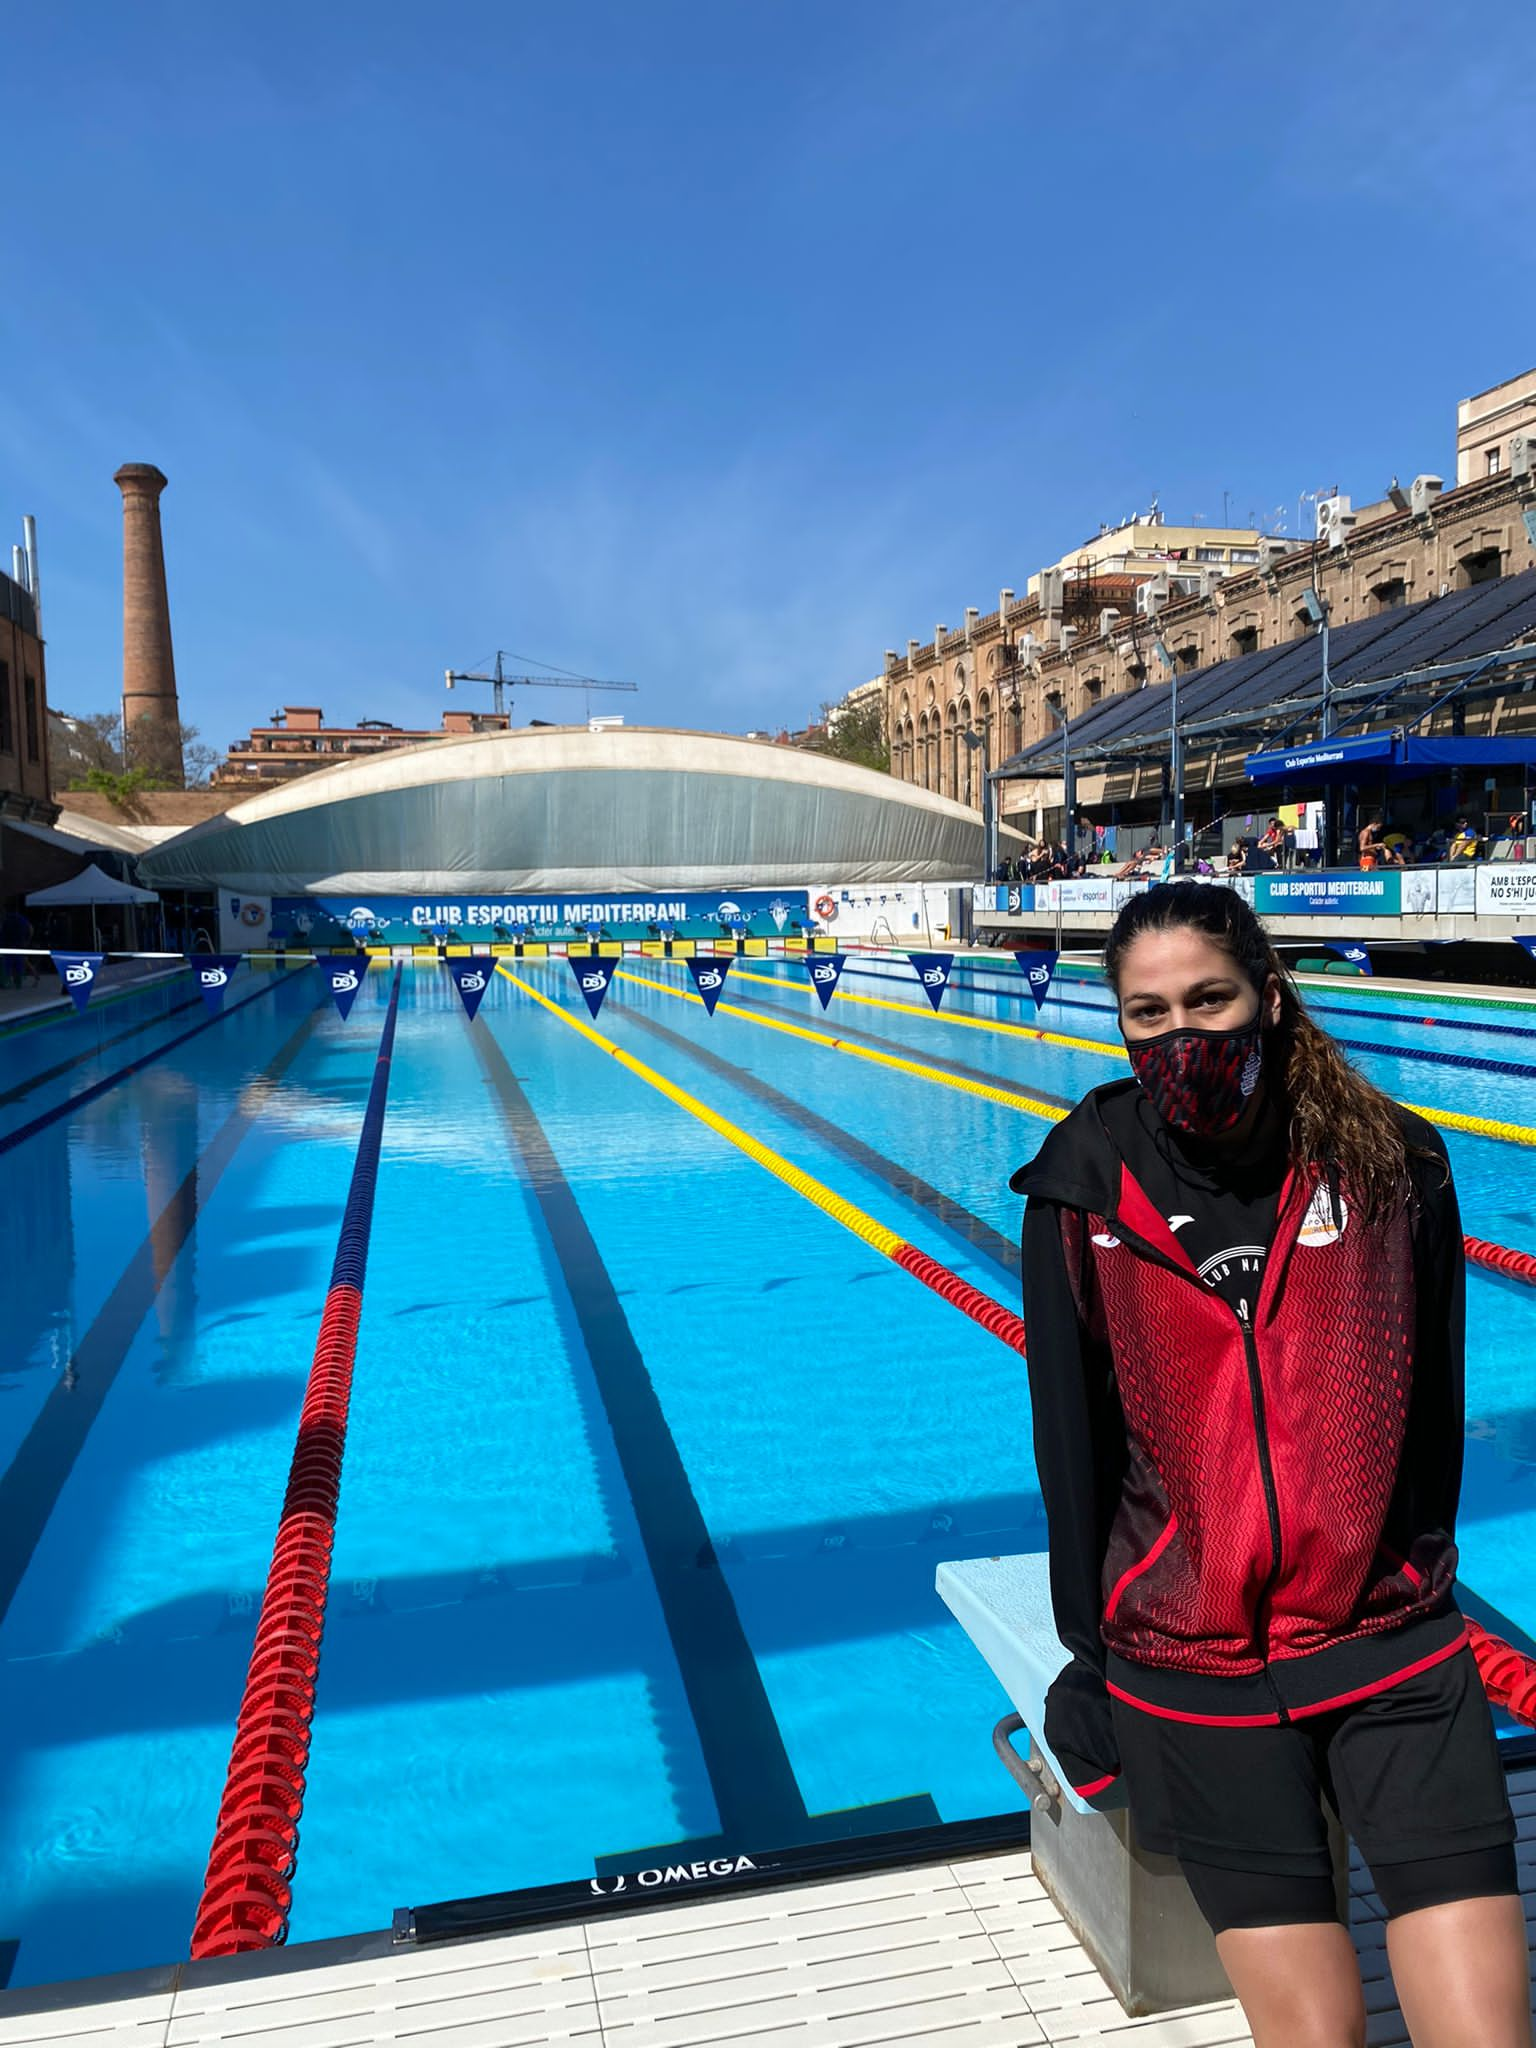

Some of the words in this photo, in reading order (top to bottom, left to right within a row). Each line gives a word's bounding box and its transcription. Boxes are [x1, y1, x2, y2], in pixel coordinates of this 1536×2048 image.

[1270, 883, 1289, 896] CLUB
[1290, 882, 1327, 896] ESPORTIU
[1328, 880, 1384, 895] MEDITERRANI
[1491, 876, 1508, 886] AMB
[1491, 888, 1503, 898] NO
[1506, 888, 1523, 898] S'HI
[1524, 888, 1536, 900] JU
[412, 905, 462, 926] CLUB
[468, 904, 557, 925] ESPORTIU
[564, 902, 687, 923] MEDITERRANI
[1203, 1264, 1230, 1287] LUB
[1241, 1258, 1259, 1272] NA
[638, 1855, 757, 1886] OMEGA
